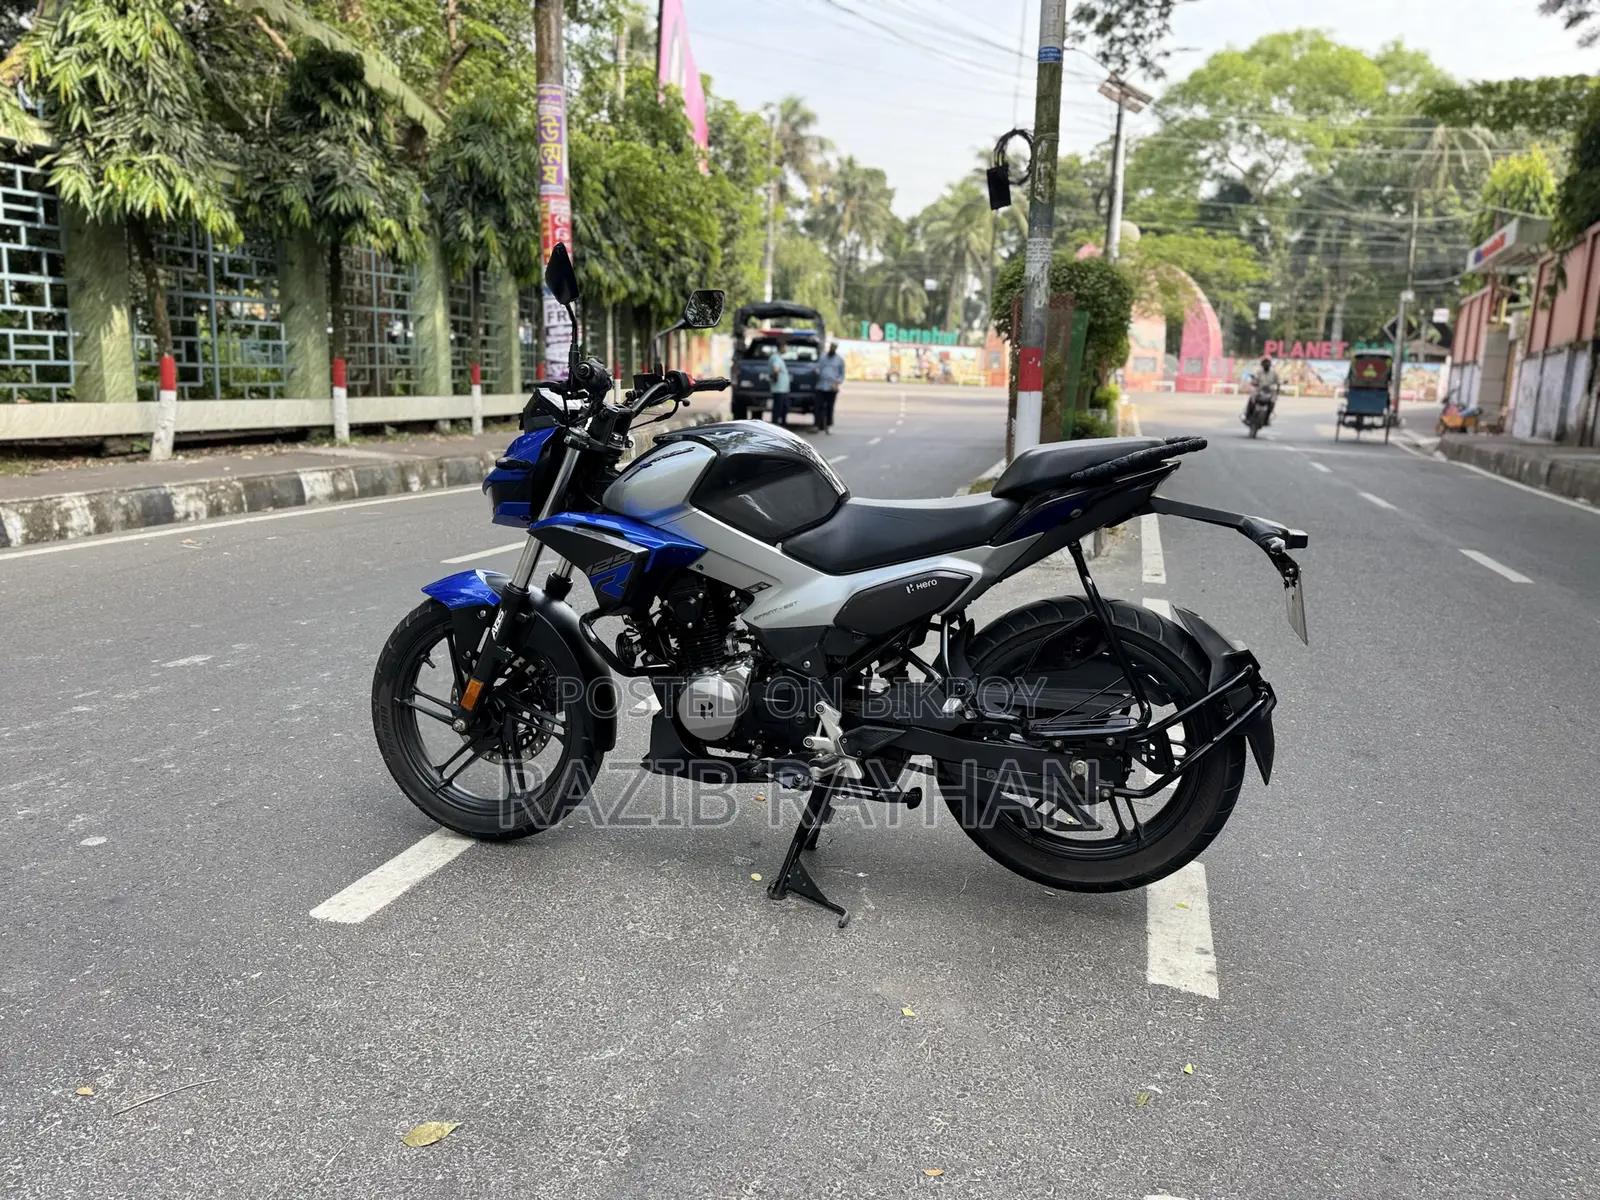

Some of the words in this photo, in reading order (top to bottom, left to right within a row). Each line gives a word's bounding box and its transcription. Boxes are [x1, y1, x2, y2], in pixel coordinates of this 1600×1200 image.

[861, 320, 870, 340] I
[1264, 340, 1348, 359] PLANET
[916, 579, 938, 590] Hero
[491, 608, 505, 642] ABS
